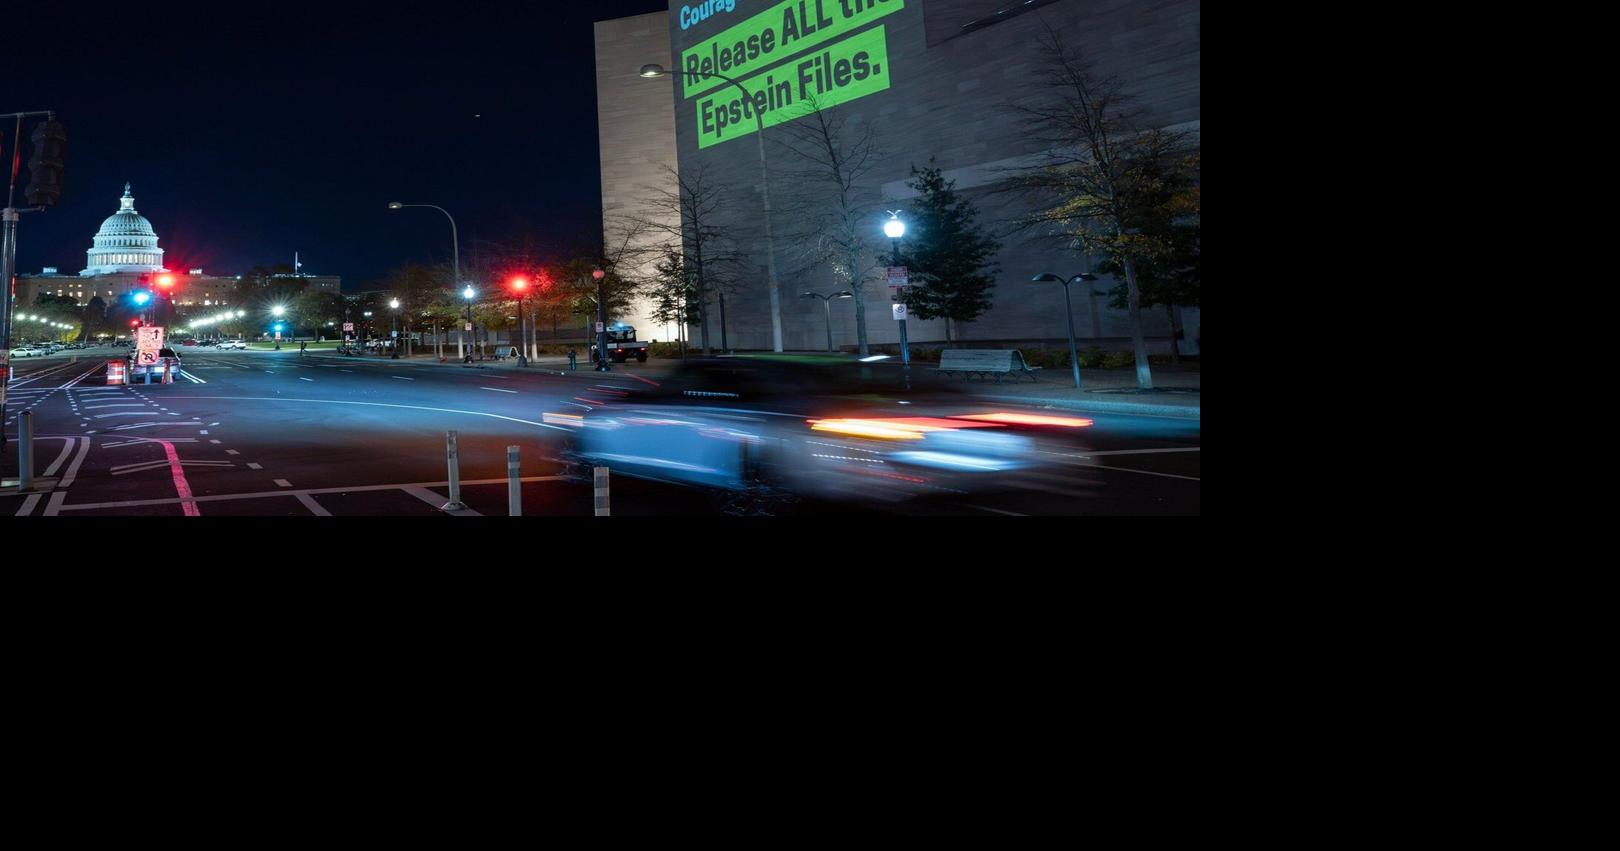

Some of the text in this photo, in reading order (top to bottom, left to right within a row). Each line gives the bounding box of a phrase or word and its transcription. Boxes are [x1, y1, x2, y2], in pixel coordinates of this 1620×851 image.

[687, 0, 833, 87] Release ALL
[702, 51, 881, 138] Epstein Files.
